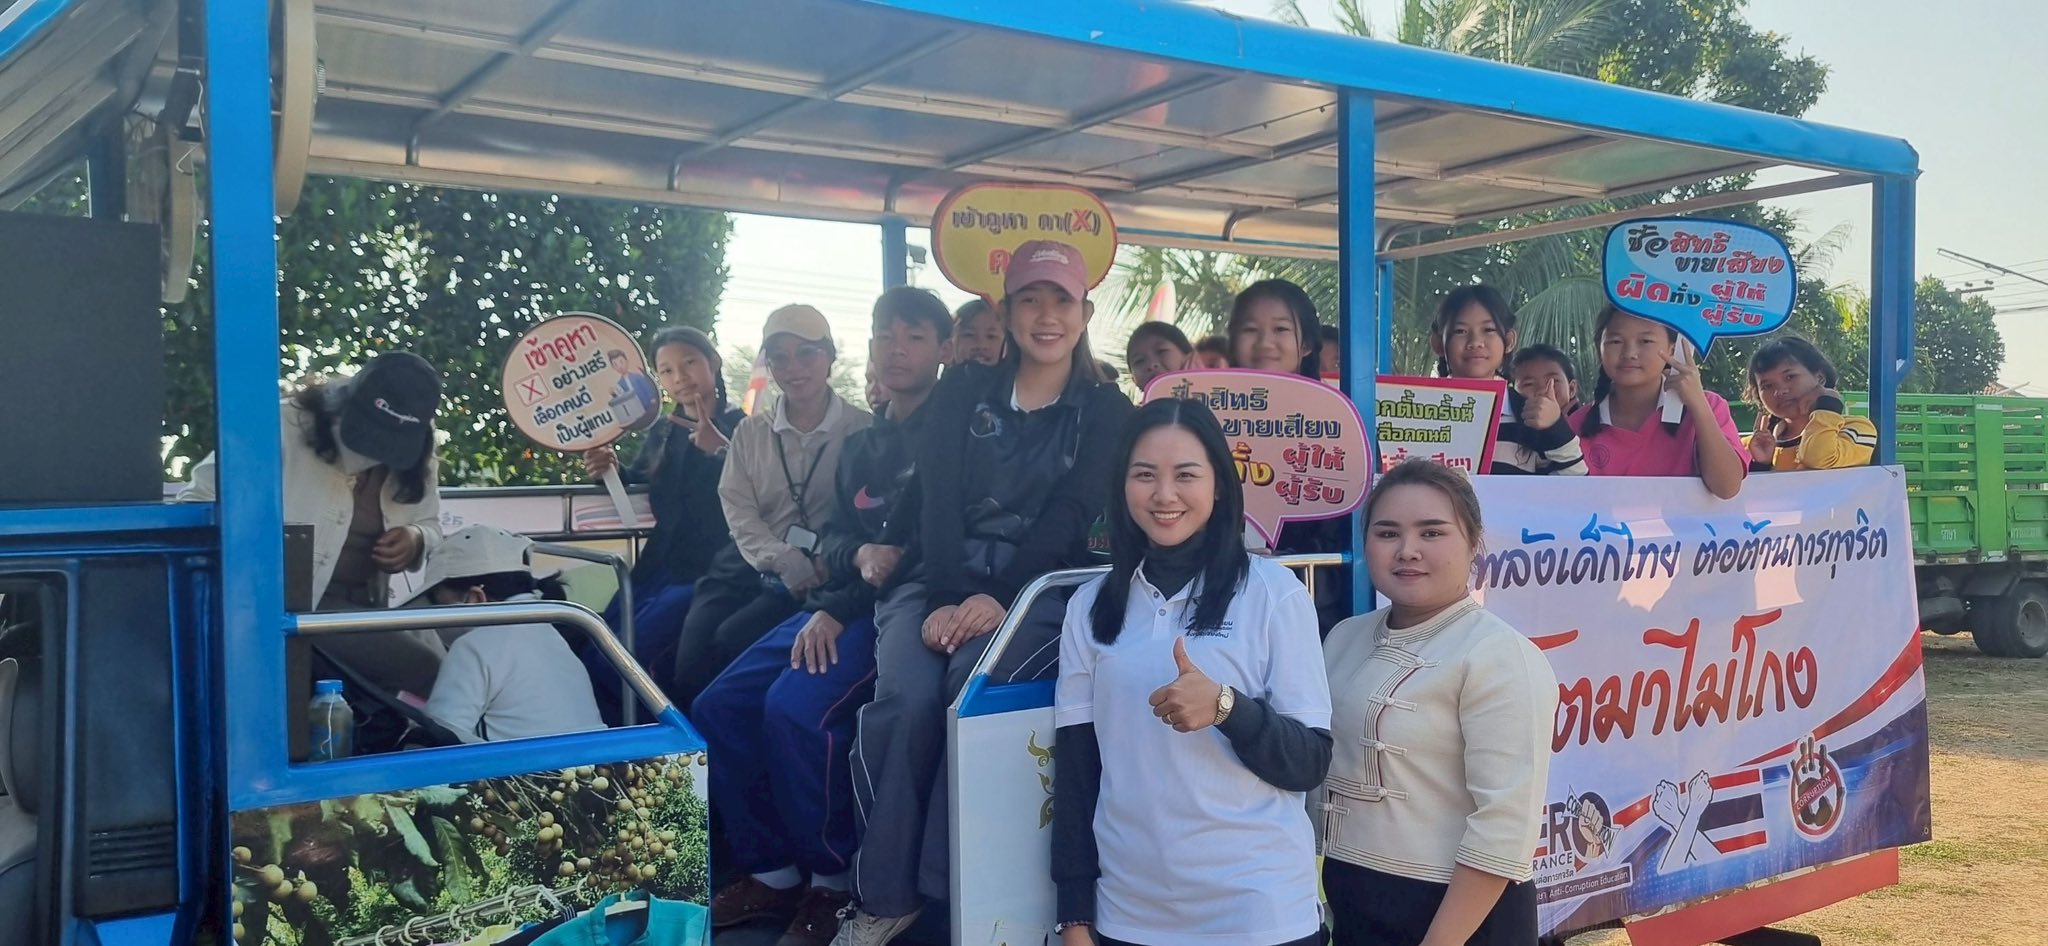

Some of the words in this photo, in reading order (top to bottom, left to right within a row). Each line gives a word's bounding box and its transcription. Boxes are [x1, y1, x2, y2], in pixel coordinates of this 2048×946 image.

[952, 206, 1028, 234] เข้าคูหา
[1675, 250, 1785, 274] ขายเสียง
[1711, 279, 1768, 302] ผู้ให้
[1702, 304, 1764, 326] ผู้รับ
[524, 321, 599, 370] เข้าคูหา
[552, 350, 607, 390] อย่างเสรี
[533, 386, 593, 426] เลือกคนดี
[556, 410, 614, 444] เป็นผู้แทน
[1223, 413, 1342, 438] ขายเสียง
[1376, 421, 1452, 443] ลือกคนดี
[1283, 442, 1346, 473] ผู้ให้
[1275, 475, 1345, 505] ผู้รับ
[1475, 512, 1682, 591] พลังเด็กไทย
[1692, 508, 1888, 580] ต่อต้านการทุจริต
[1796, 776, 1832, 810] CORRUPTION
[1532, 852, 1573, 872] RANCE
[1549, 880, 1599, 898] Anti-Corruption
[1600, 871, 1628, 886] Education
